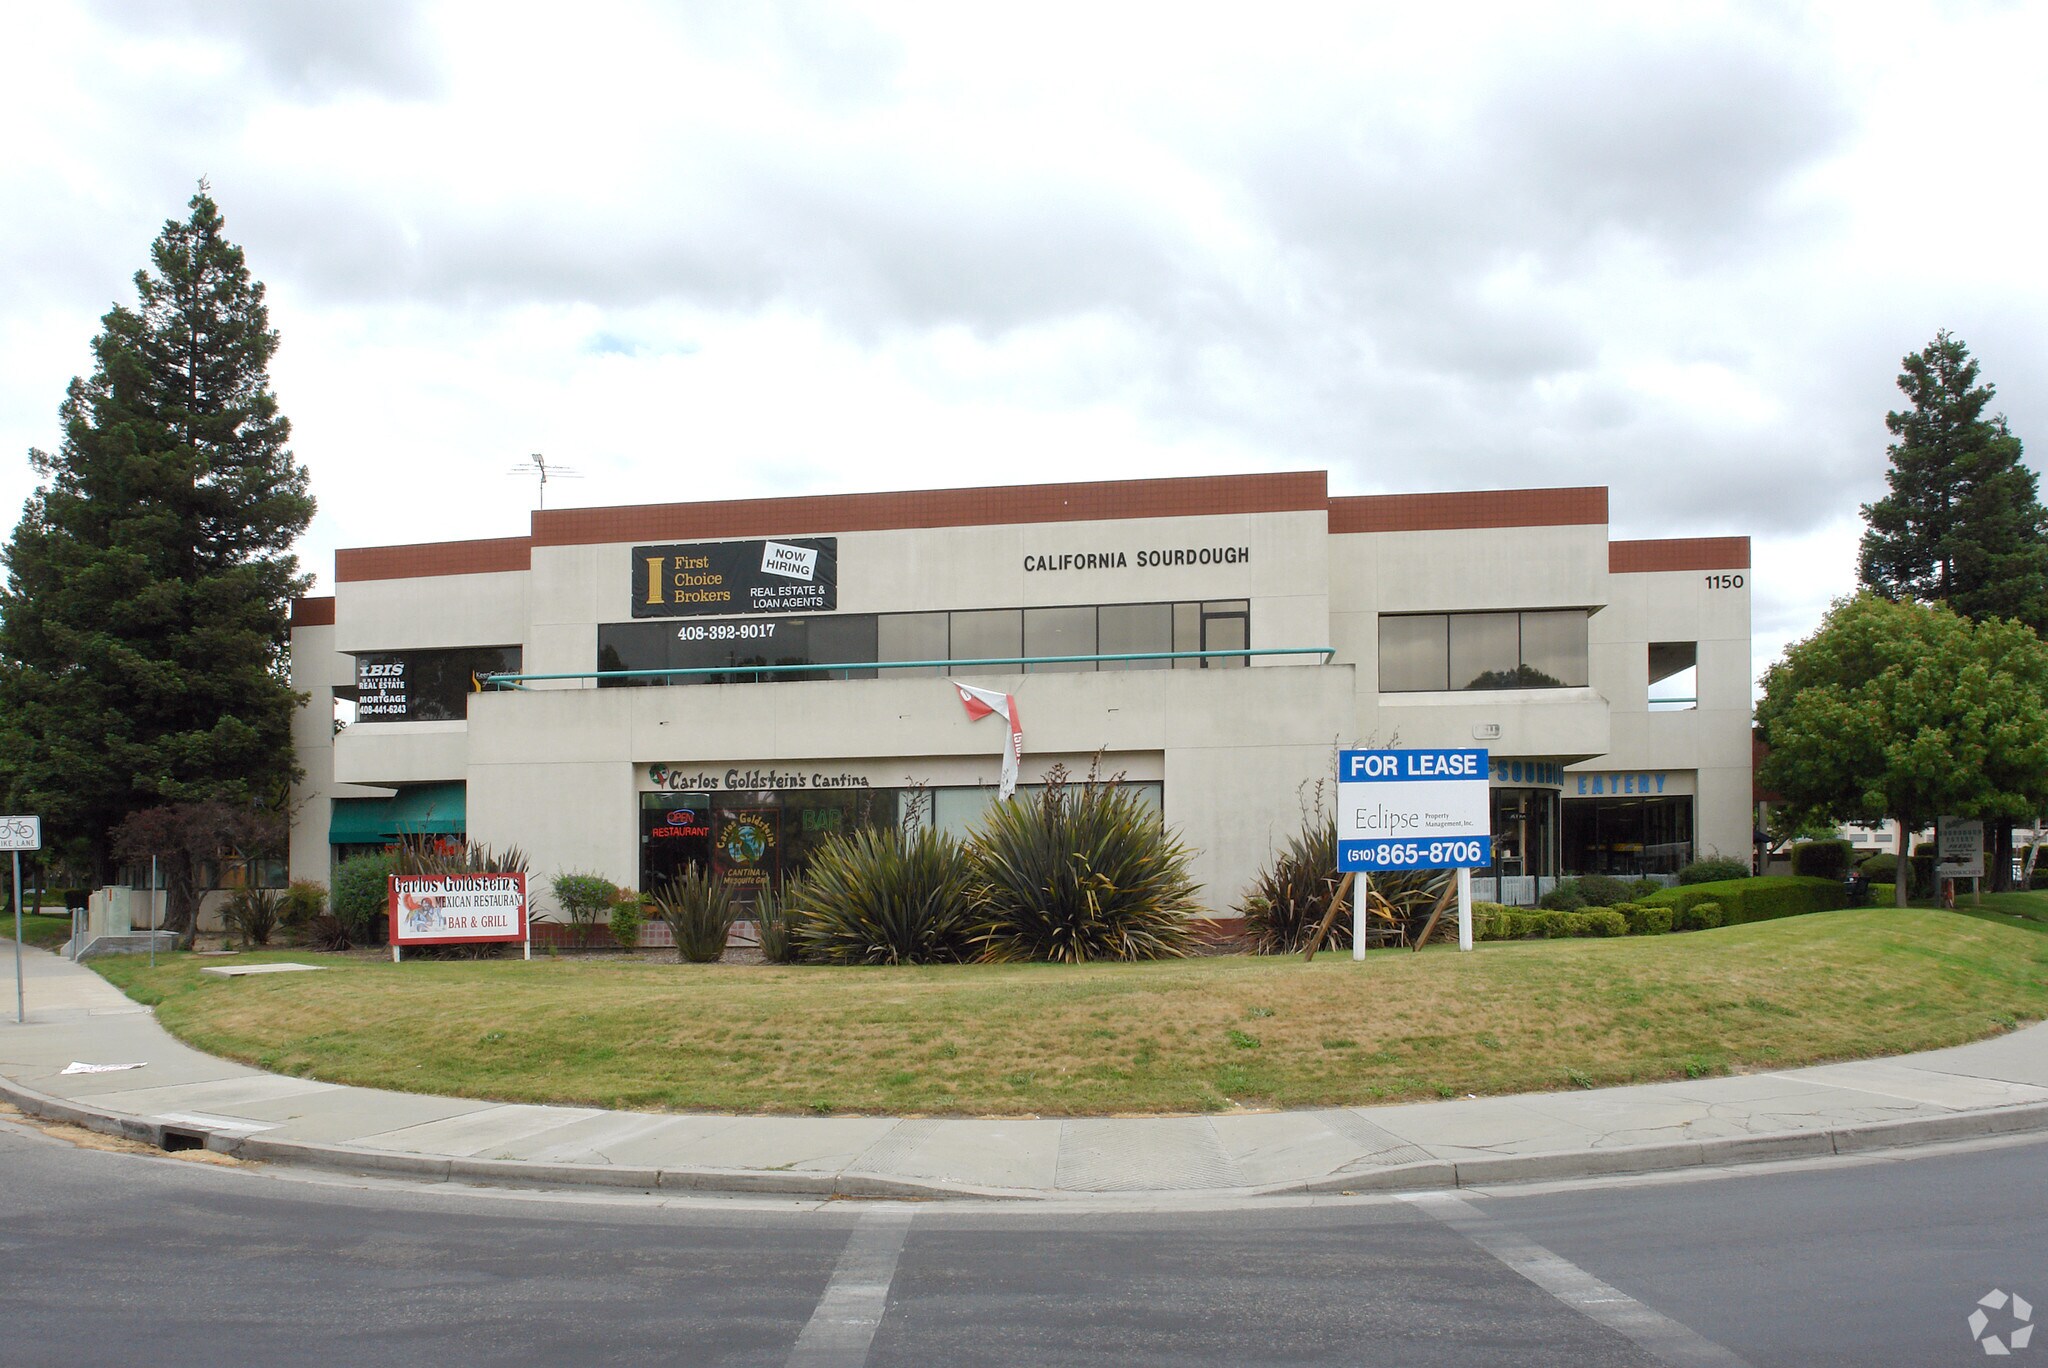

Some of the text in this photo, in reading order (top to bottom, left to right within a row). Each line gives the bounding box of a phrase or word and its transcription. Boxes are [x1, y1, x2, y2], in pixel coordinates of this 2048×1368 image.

[775, 548, 807, 562] NOW
[1024, 547, 1249, 571] CALIFORNIA SOURDOUGH
[674, 556, 709, 570] First
[766, 559, 811, 576] HIRING
[674, 572, 723, 587] Choice
[1705, 575, 1744, 589] 1150
[674, 589, 731, 603] Brokers
[750, 585, 826, 597] REAL ESTATE &
[753, 597, 823, 609] LOAN AGENTS
[677, 623, 776, 641] 408-392-9017
[359, 681, 405, 690] REAL ESTATE
[359, 695, 407, 704] MORTGAGE
[359, 704, 407, 715] 408-441-6243
[1351, 755, 1398, 777] FOR
[1408, 754, 1478, 776] LEASE
[669, 769, 869, 790] Carlos Goldstein's Cantina
[1577, 774, 1667, 795] EATERY
[667, 811, 694, 823] OPEN
[803, 809, 842, 832] BAR
[1356, 803, 1419, 836] Eclipse
[1425, 813, 1449, 821] Property
[652, 827, 710, 838] RESTAURANT
[716, 820, 737, 849] Carlos
[0, 839, 35, 847] IKE LANE
[1347, 841, 1481, 866] (510) 865-8706
[727, 868, 761, 877] CANTINA
[393, 875, 519, 893] Carlos Goldstein's
[435, 894, 524, 908] MEXICAN RESTAURANT
[448, 915, 508, 929] BAR & GRILL
